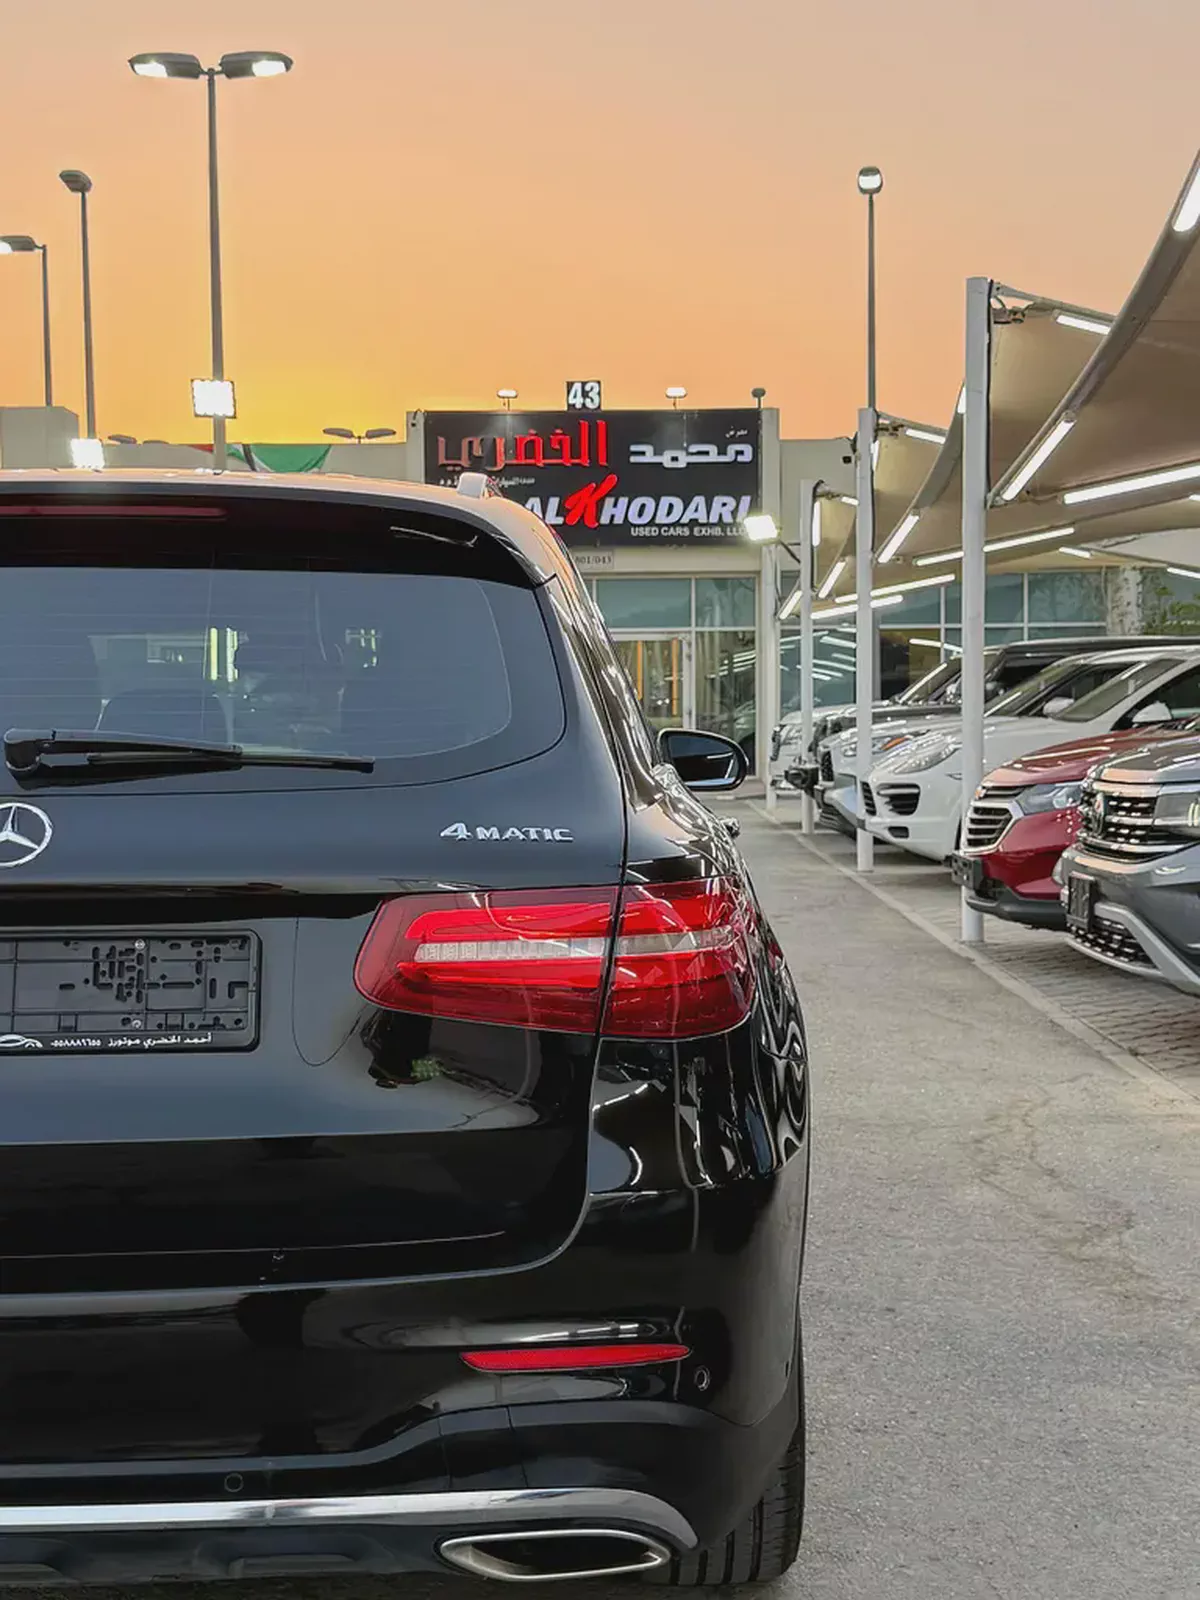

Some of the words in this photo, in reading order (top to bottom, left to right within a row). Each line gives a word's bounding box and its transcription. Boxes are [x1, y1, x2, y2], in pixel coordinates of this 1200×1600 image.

[568, 382, 600, 409] 43
[437, 419, 609, 471] الخضري
[629, 443, 753, 468] محمد
[631, 526, 659, 536] USED
[661, 526, 690, 536] CARS
[184, 1032, 212, 1044] أحمد
